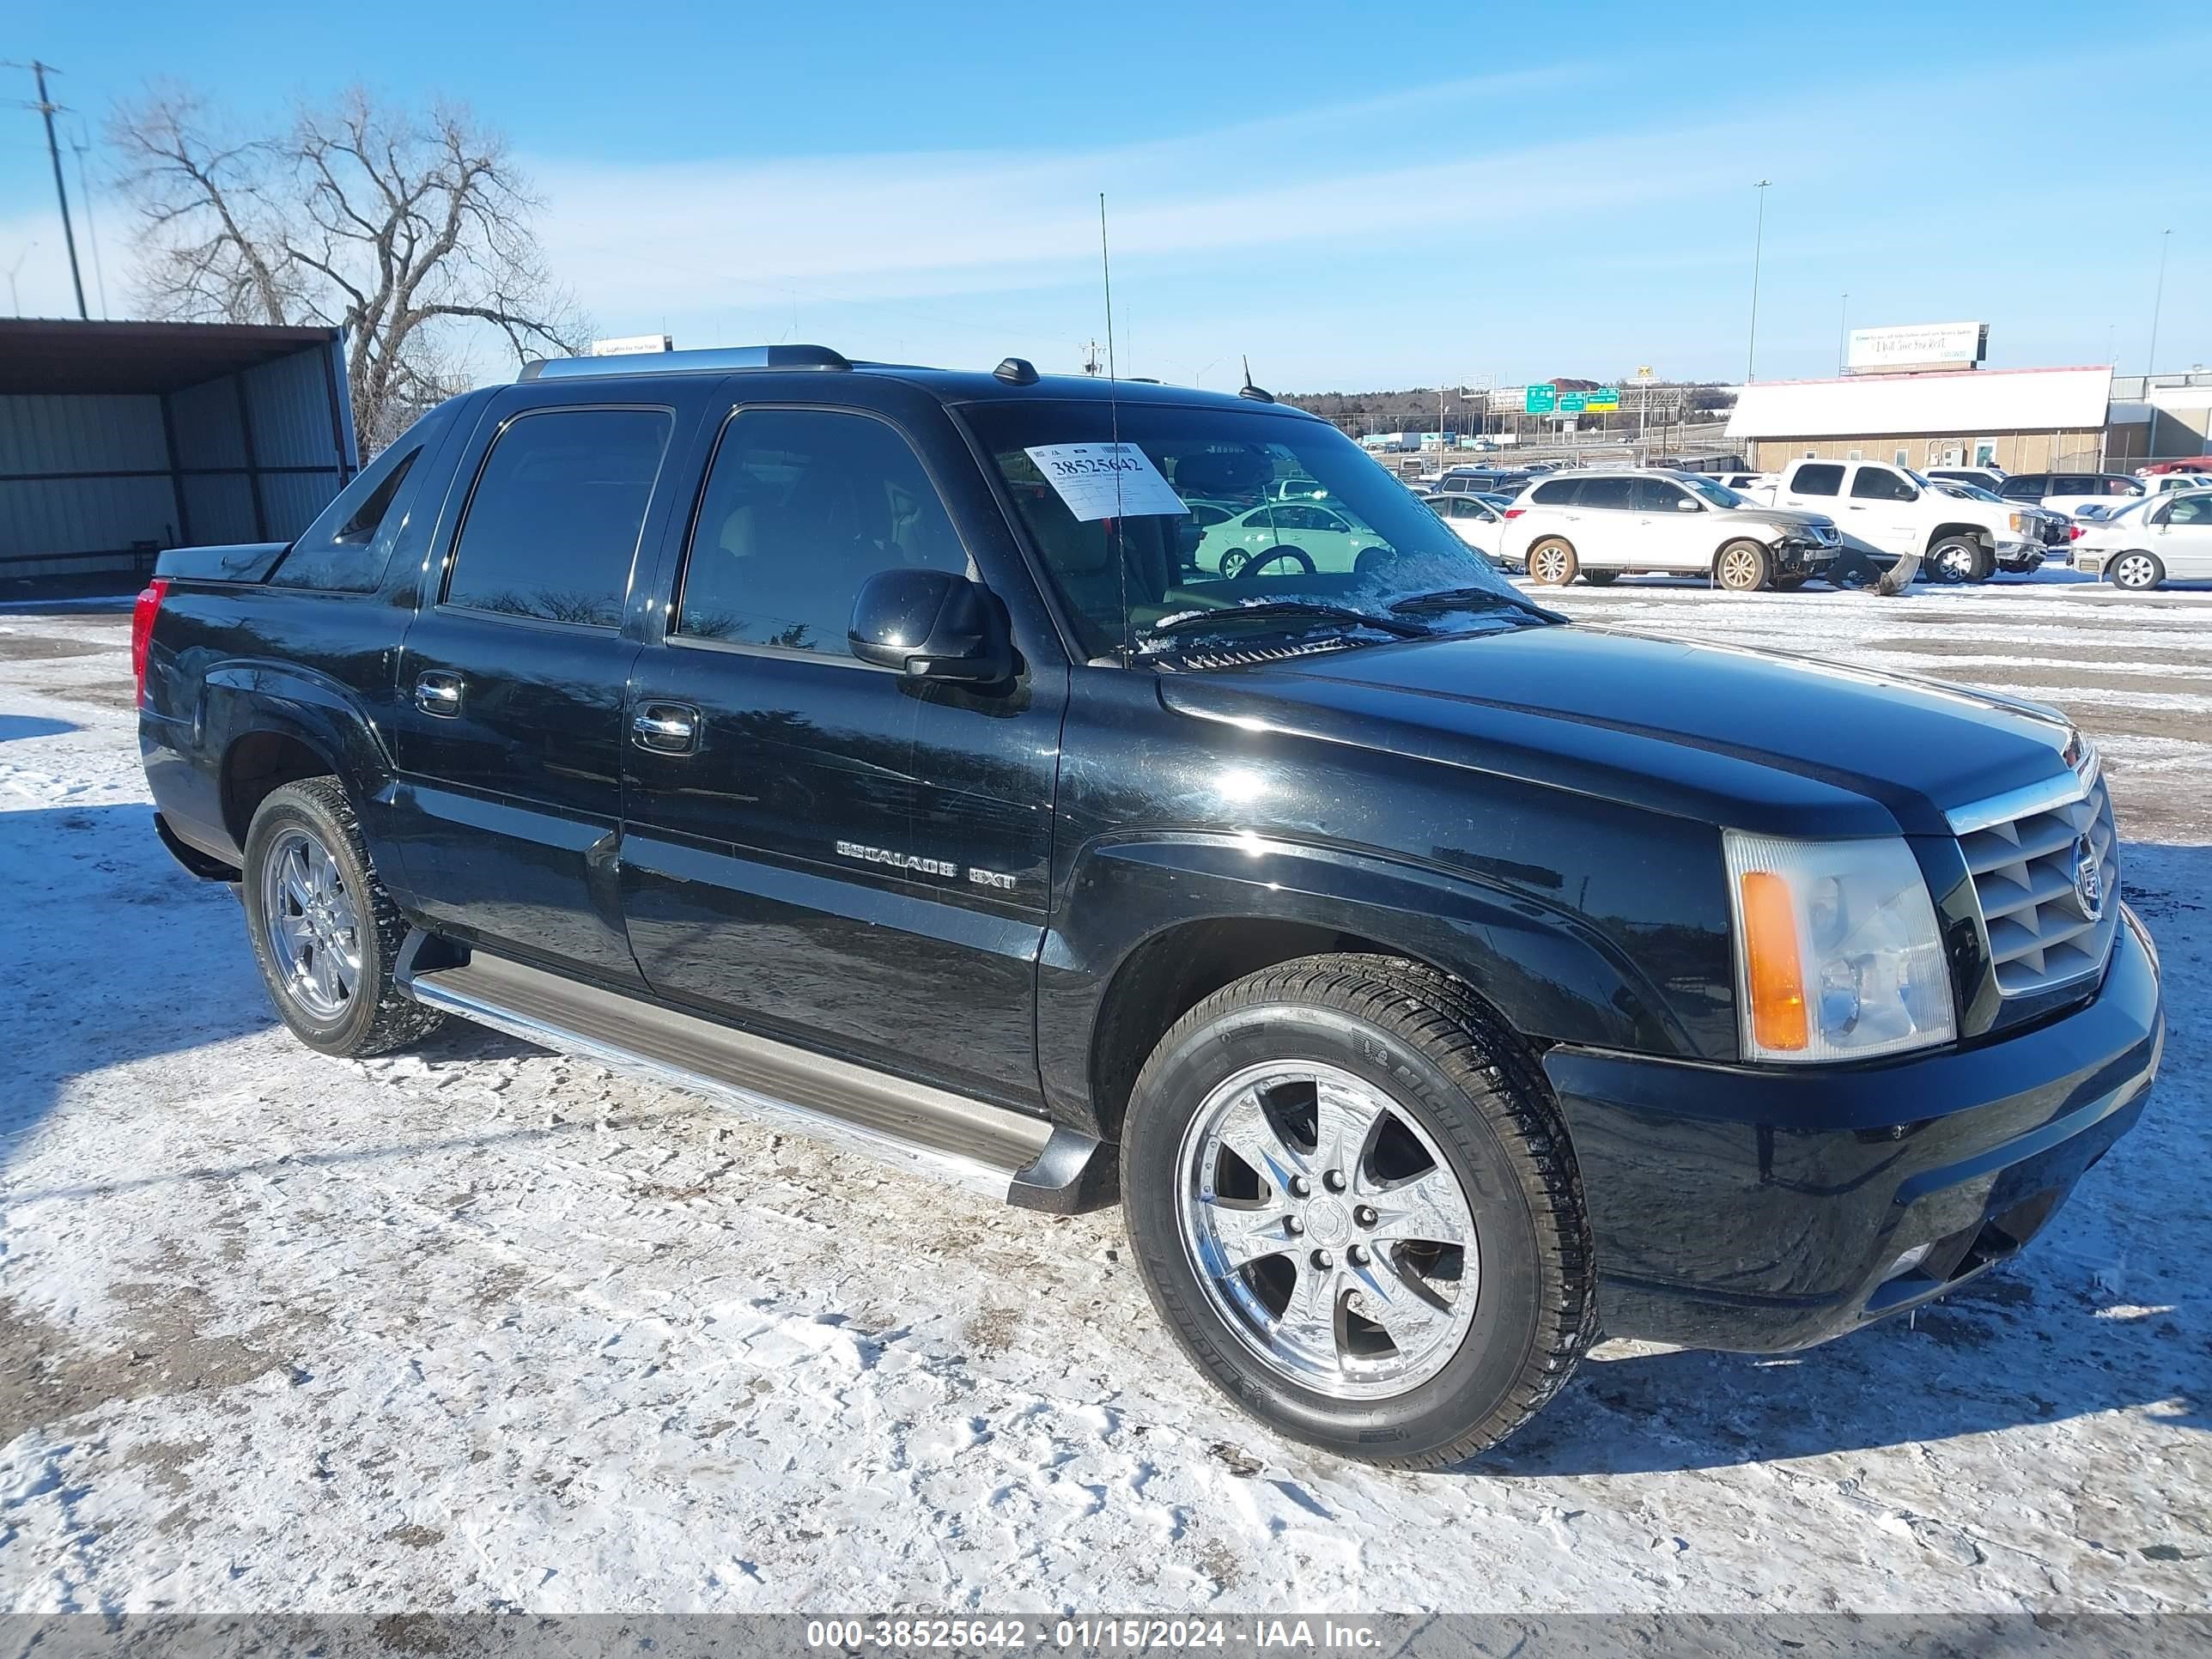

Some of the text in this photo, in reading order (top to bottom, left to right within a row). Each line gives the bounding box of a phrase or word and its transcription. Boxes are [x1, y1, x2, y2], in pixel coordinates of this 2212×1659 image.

[1050, 457, 1144, 476] 38525642
[836, 839, 1018, 890] ESCALADE EXT
